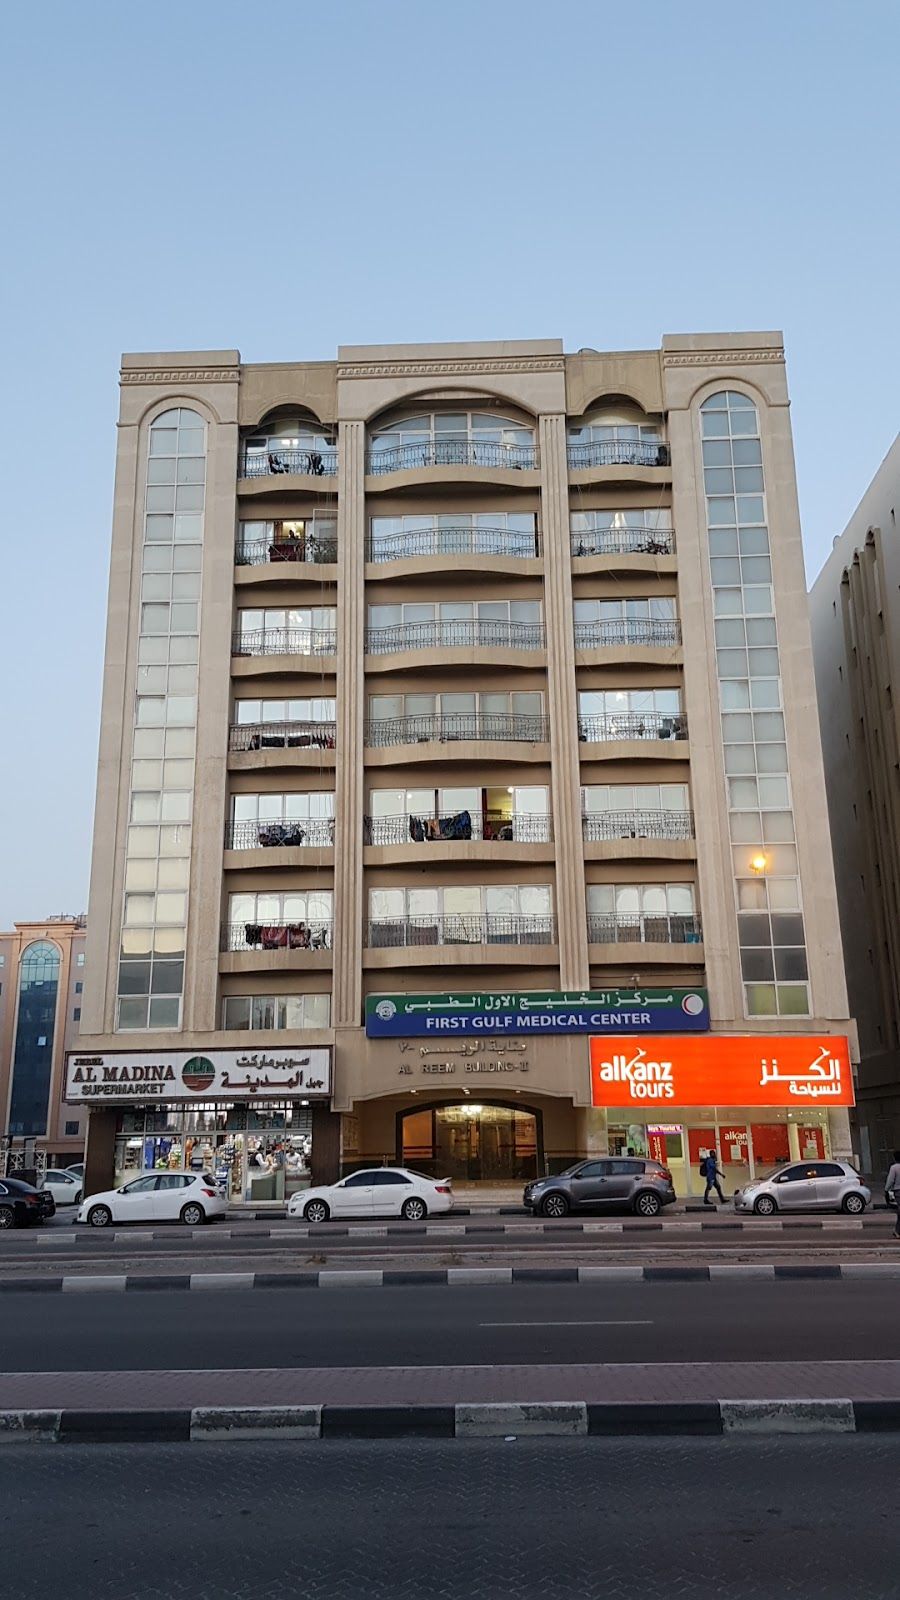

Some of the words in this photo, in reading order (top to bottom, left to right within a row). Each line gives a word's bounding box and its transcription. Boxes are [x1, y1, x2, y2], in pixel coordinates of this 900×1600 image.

[404, 996, 480, 1013] الطبي
[519, 993, 611, 1010] الخليج
[613, 991, 674, 1006] مركز
[426, 1017, 469, 1029] FIRST
[472, 1016, 513, 1028] GULF
[516, 1014, 588, 1027] MEDICAL
[590, 1013, 651, 1025] CENTER
[399, 1064, 413, 1075] AL
[422, 1063, 455, 1074] REEM
[600, 1047, 674, 1081] alkanz
[759, 1047, 841, 1085] الكنز
[72, 1067, 97, 1083] AL
[101, 1065, 176, 1082] MADINA
[221, 1070, 303, 1093] المدينة
[81, 1083, 165, 1095] SUPERMARKET
[630, 1081, 675, 1098] tours
[789, 1081, 842, 1097] للسياحة
